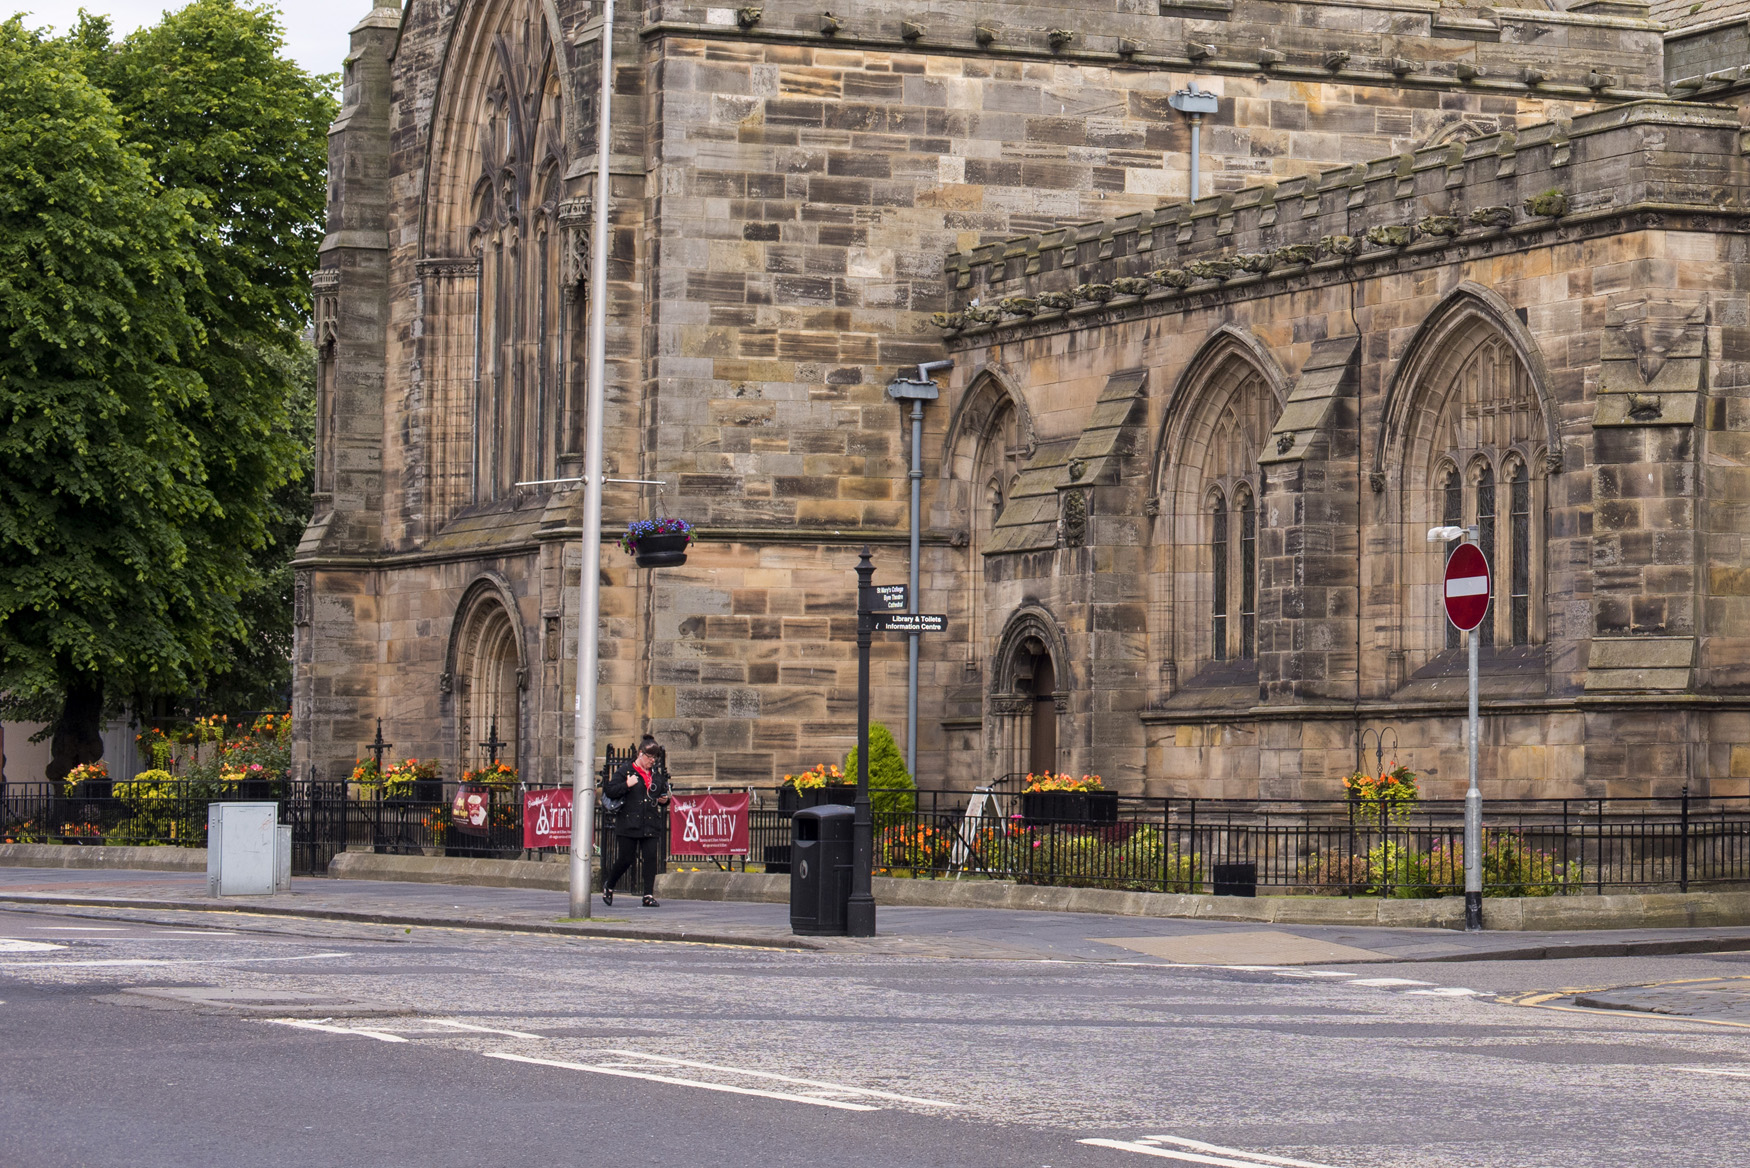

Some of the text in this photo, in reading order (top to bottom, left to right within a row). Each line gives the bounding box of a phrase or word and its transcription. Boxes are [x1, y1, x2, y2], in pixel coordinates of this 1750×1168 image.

[892, 615, 914, 623] Library
[549, 802, 573, 828] trini
[699, 808, 736, 841] trinity
